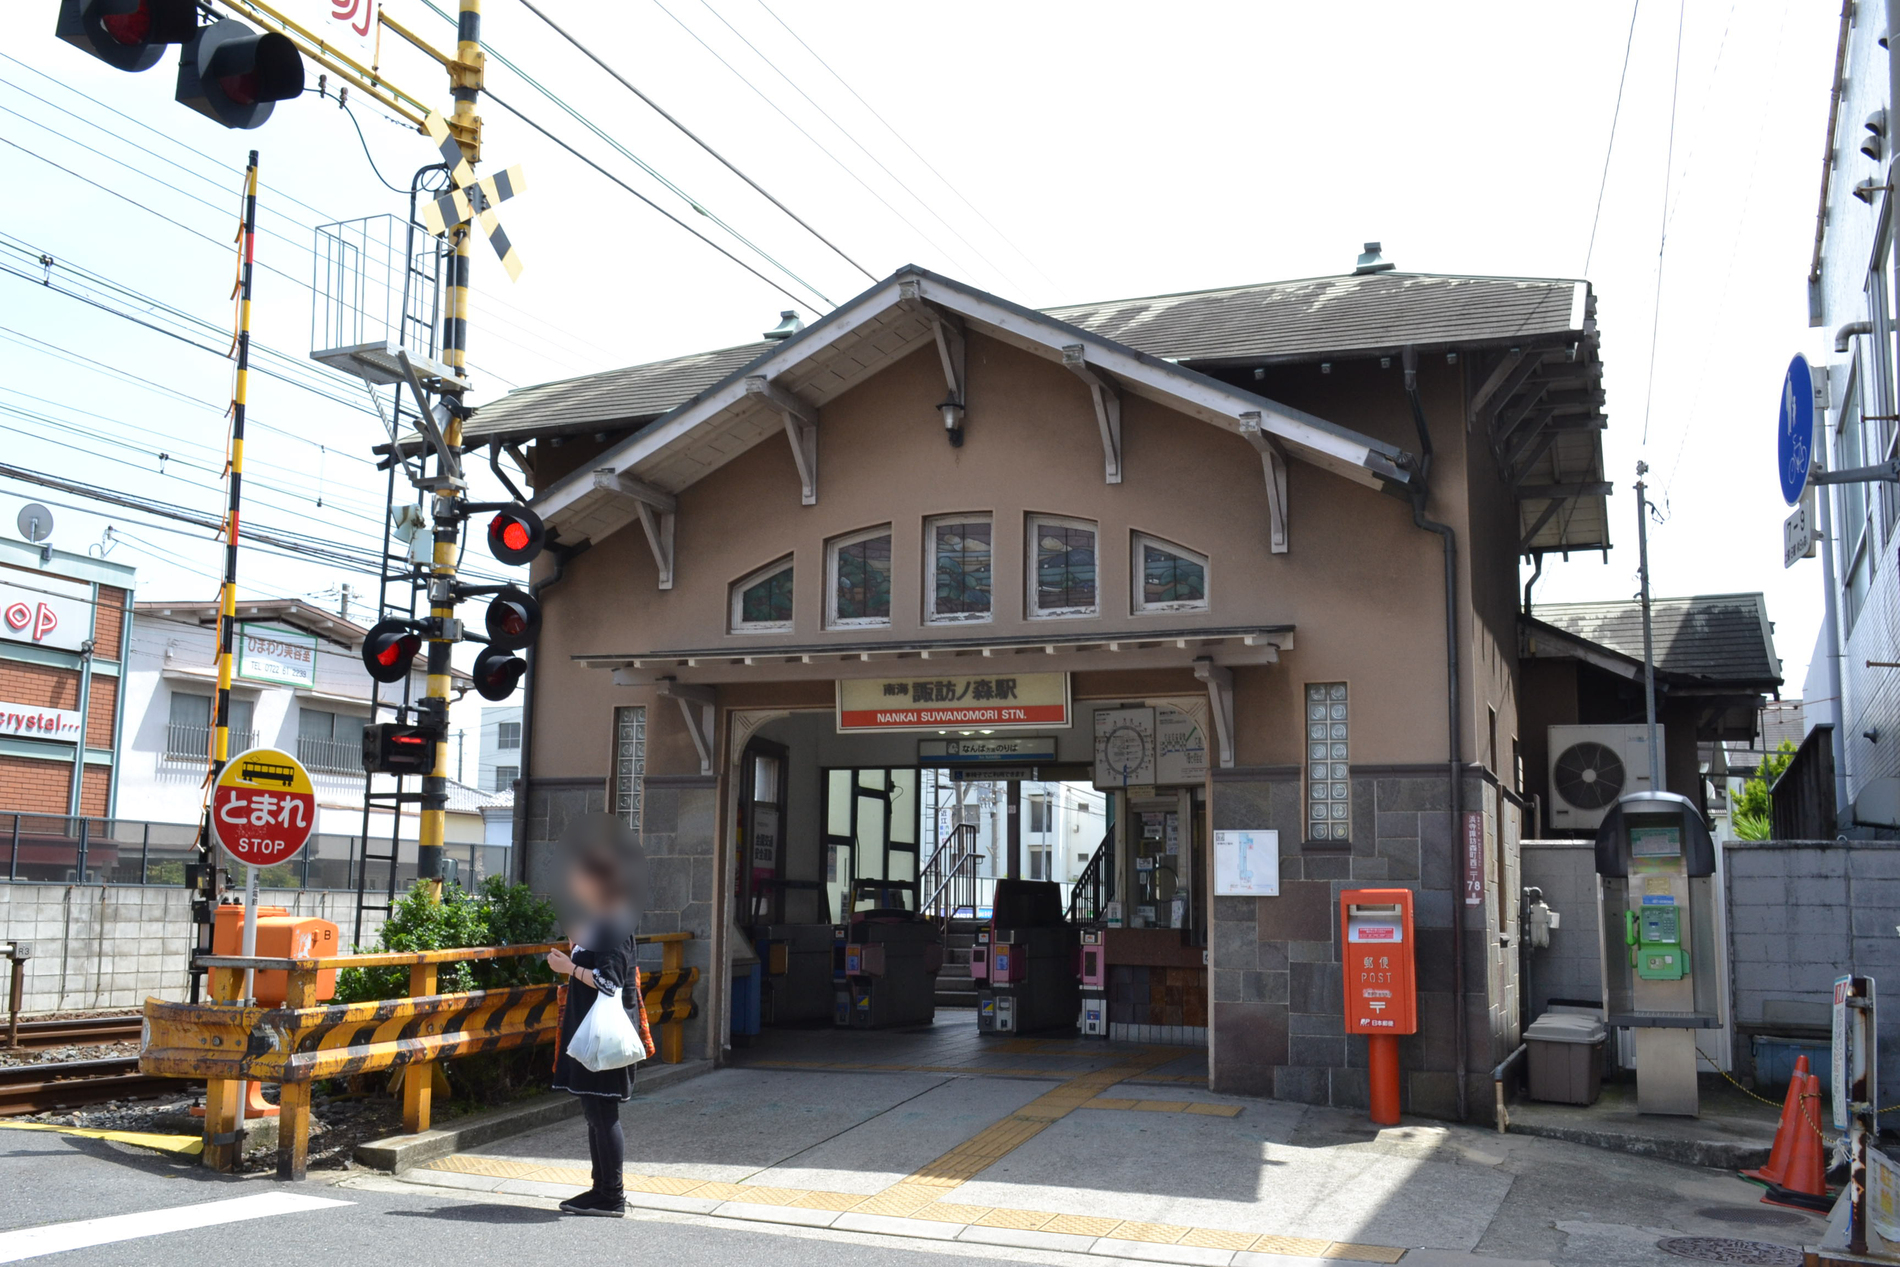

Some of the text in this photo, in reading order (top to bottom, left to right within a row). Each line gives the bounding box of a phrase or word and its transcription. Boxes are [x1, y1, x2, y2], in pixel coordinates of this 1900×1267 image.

[251, 661, 261, 671] TEL
[883, 678, 1018, 703] 南海 諏訪ノ森駅
[877, 709, 1027, 723] NANKAI SUWANOMORI STN.
[220, 790, 307, 828] とまれ
[238, 838, 285, 854] STOP
[1467, 881, 1481, 891] 78
[324, 929, 332, 941] B
[1363, 957, 1389, 969] 郵便
[1361, 973, 1392, 983] POST
[1371, 1019, 1394, 1027] 日本郵便
